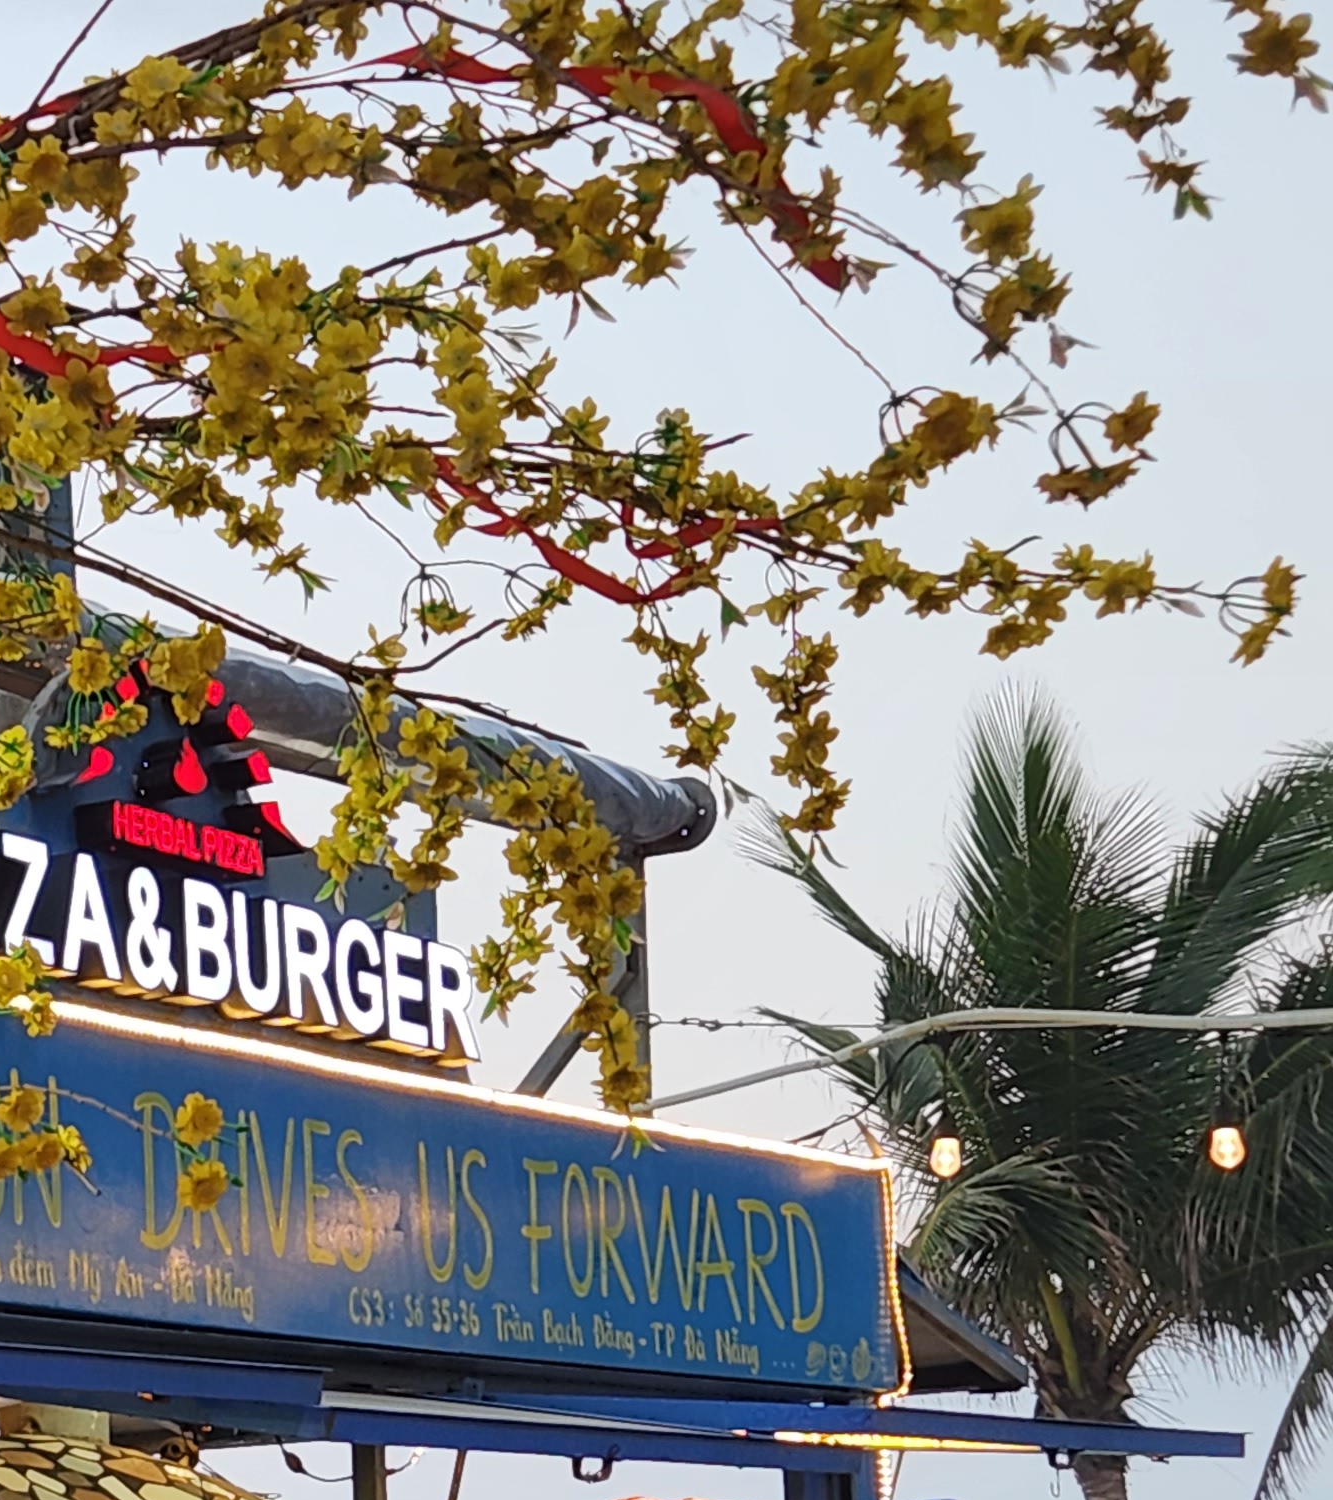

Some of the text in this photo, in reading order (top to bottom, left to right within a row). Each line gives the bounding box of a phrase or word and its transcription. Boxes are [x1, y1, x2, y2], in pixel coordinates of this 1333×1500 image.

[113, 800, 265, 877] HERBAL PIZZA
[417, 1140, 494, 1291] US
[520, 1156, 827, 1334] FORWARD
[115, 1256, 145, 1299] An
[543, 1307, 585, 1354] Bạch
[650, 1321, 675, 1358] TP
[684, 1324, 706, 1362] Đà
